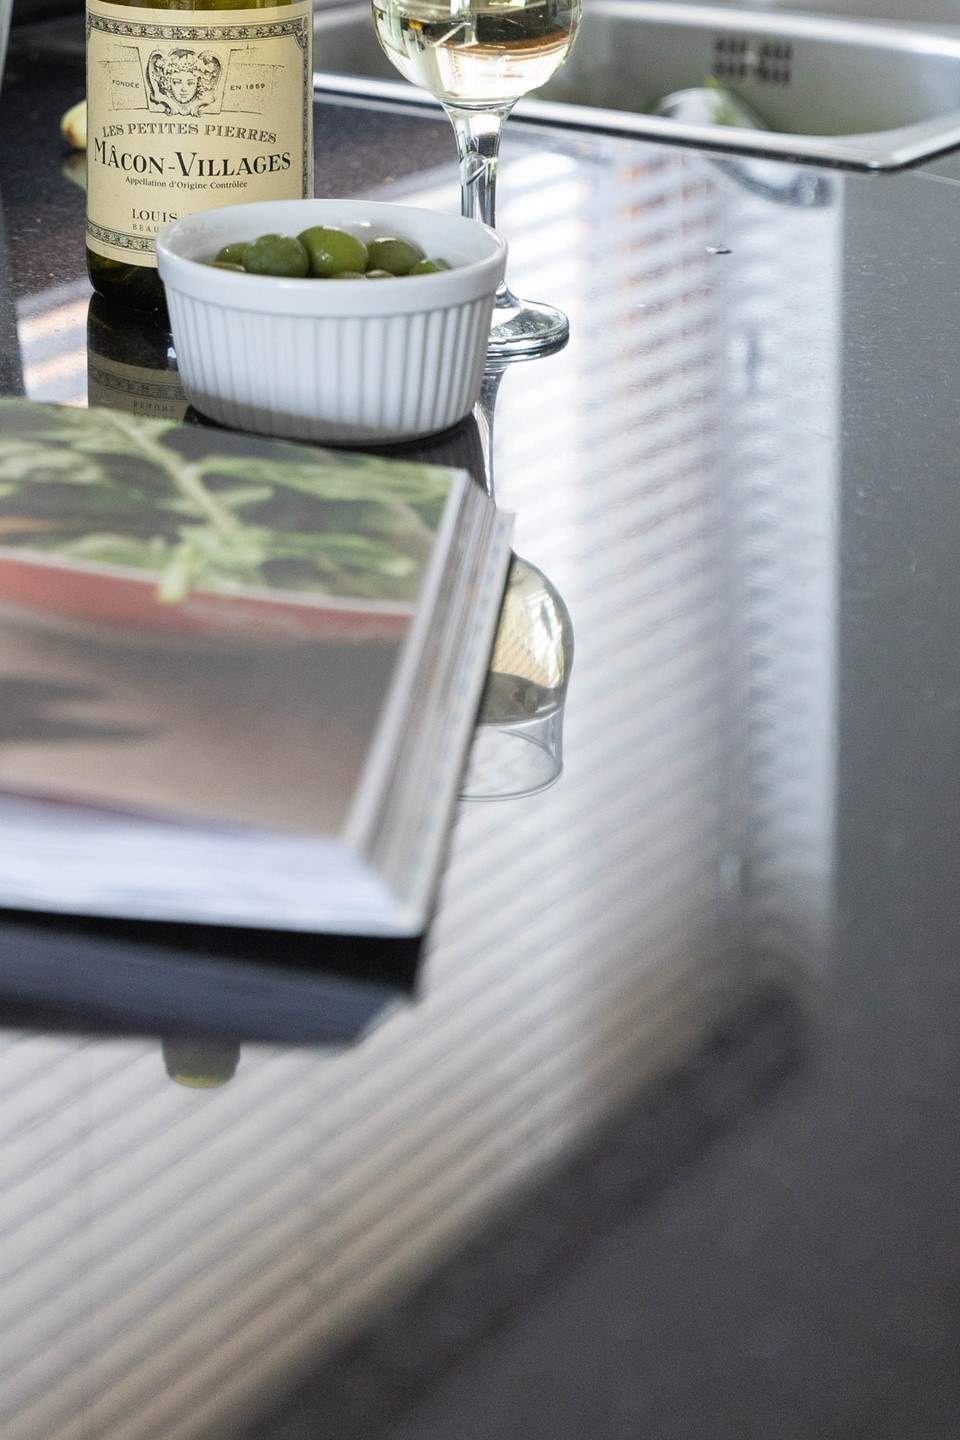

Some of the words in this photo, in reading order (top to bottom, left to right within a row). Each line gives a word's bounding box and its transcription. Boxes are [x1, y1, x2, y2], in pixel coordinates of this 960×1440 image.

[102, 124, 125, 138] LES
[128, 122, 199, 136] PETITES
[205, 125, 277, 144] PIERRES
[125, 176, 166, 187] Appellation
[131, 208, 178, 223] LOUIS
[132, 223, 160, 232] BEAU
